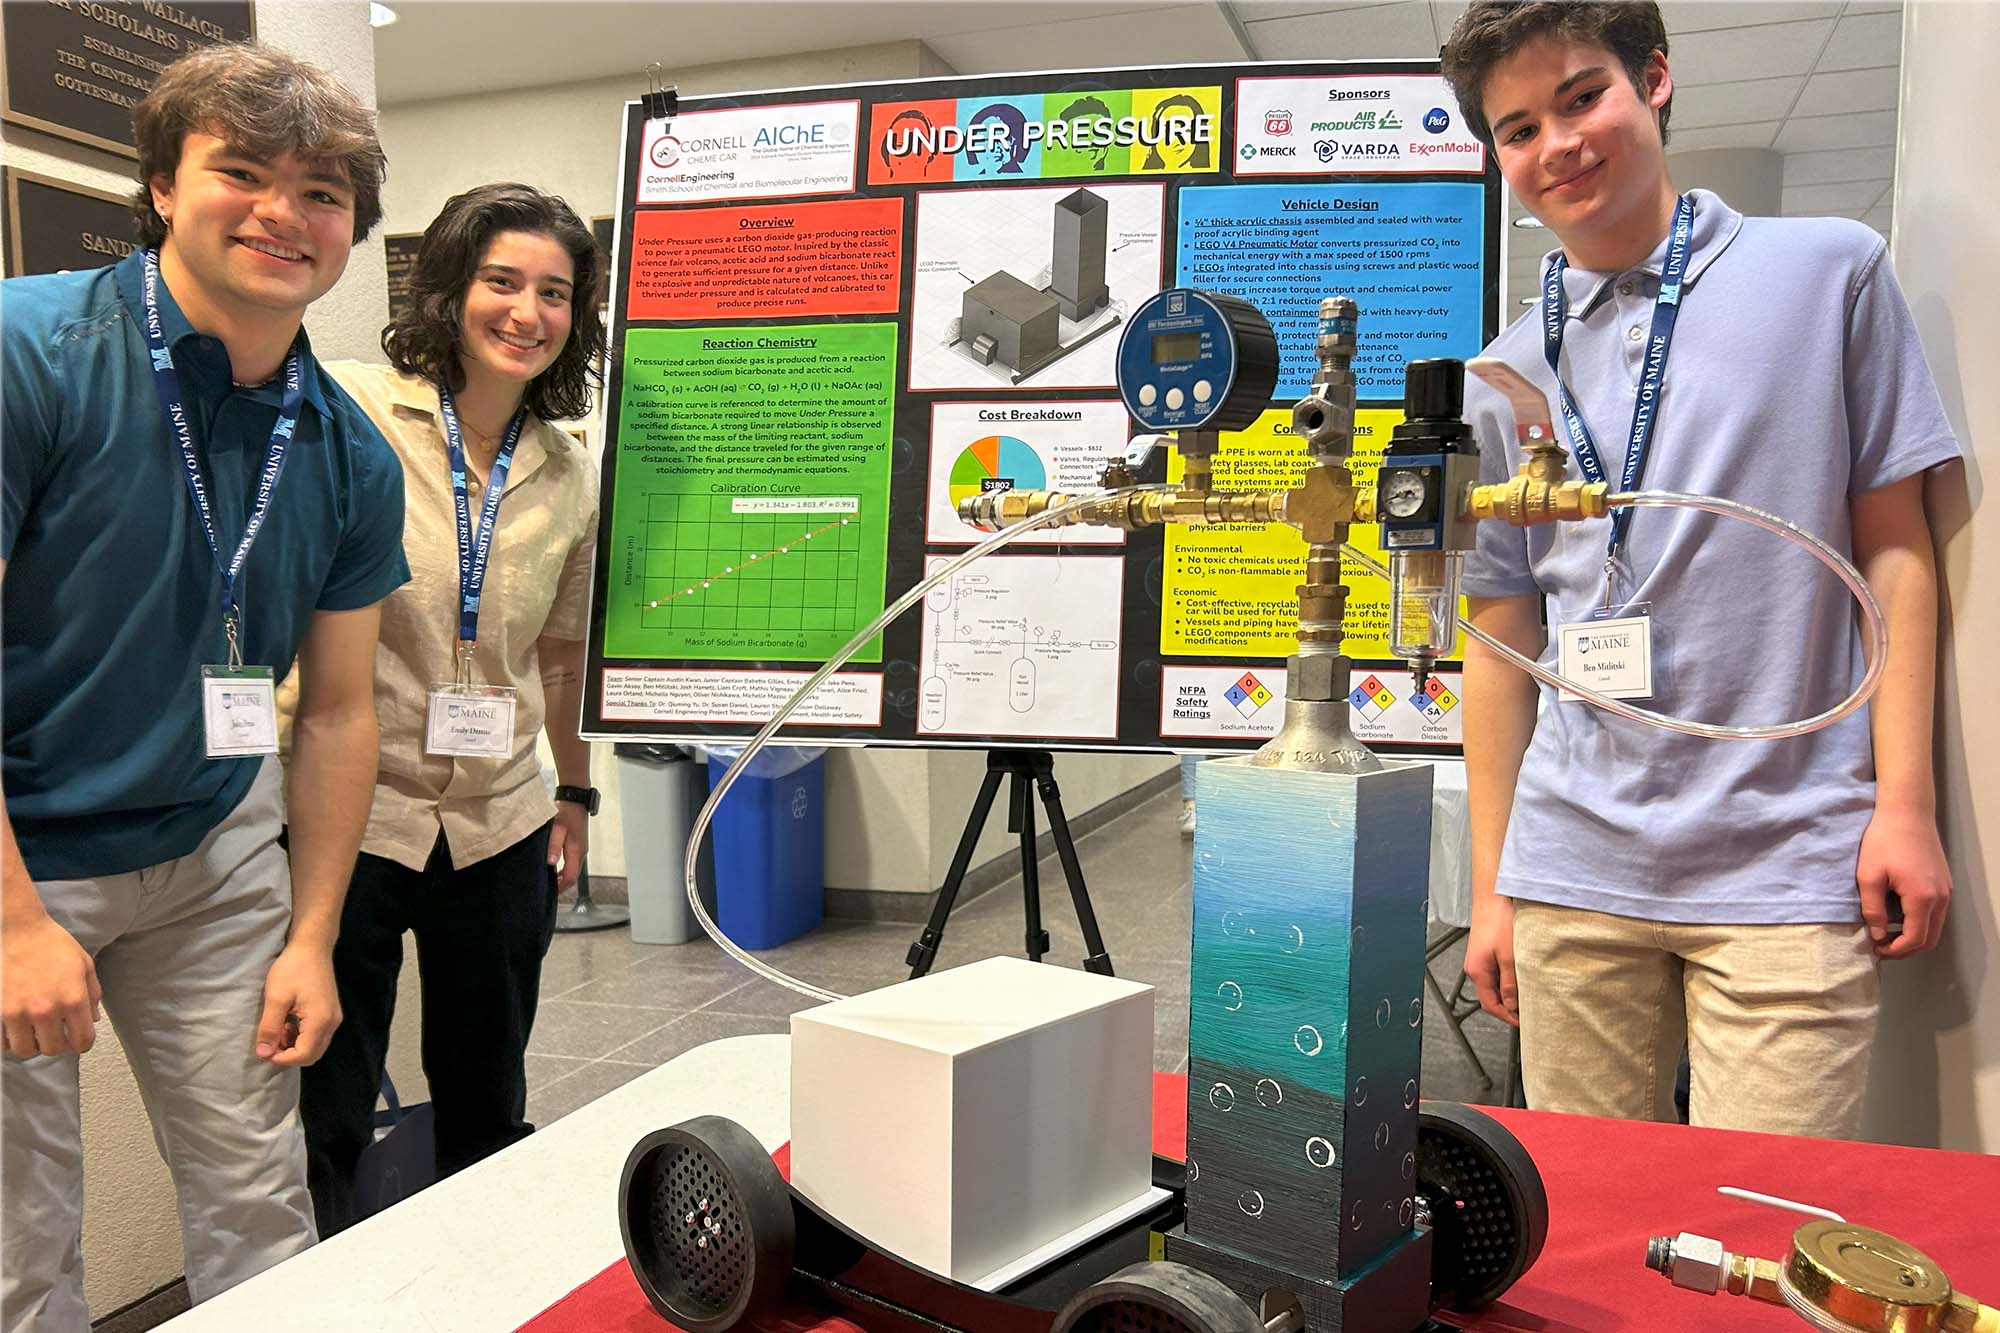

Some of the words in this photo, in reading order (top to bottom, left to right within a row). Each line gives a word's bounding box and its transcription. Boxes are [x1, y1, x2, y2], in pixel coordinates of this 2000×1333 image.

[79, 0, 179, 50] SCHOLARS
[141, 0, 224, 42] WALLACH
[56, 50, 86, 70] THE
[1329, 89, 1390, 98] Sponsors
[1354, 112, 1376, 121] AIR
[1427, 116, 1447, 127] P&G
[1268, 120, 1289, 131] 66
[1310, 122, 1376, 131] PRODUCTS
[754, 124, 824, 147] AIChE
[886, 122, 1012, 156] UNDER
[1022, 113, 1215, 149] PRESSURE
[680, 135, 747, 153] CORNELL
[1342, 144, 1399, 155] VARDA
[1409, 143, 1479, 156] ExxonMobil
[1260, 147, 1296, 157] MERCK
[687, 154, 717, 165] CHEME
[719, 152, 737, 162] CAR
[647, 170, 735, 184] CornellEngineering
[645, 186, 667, 194] Smith
[668, 185, 694, 193] School
[695, 184, 703, 192] of
[703, 181, 737, 191] Chemical
[755, 178, 803, 188] Biomolecular
[804, 175, 848, 186] Engineering
[1282, 199, 1329, 209] Vehicle
[1334, 198, 1379, 209] Design
[739, 216, 794, 227] Overview
[638, 238, 665, 246] Under
[666, 238, 703, 246] Pressure
[732, 234, 762, 243] carbon
[764, 232, 795, 242] dioxide
[797, 229, 859, 241] gas-producing
[861, 227, 896, 237] reaction
[1194, 227, 1220, 240] proof
[1222, 228, 1252, 239] acrylic
[1254, 228, 1290, 238] binding
[1292, 228, 1319, 238] agent
[81, 232, 136, 258] SAND
[1668, 212, 1690, 275] UNIVERSITY
[1194, 249, 1245, 261] mechanical
[1248, 253, 1280, 261] energy
[1282, 250, 1303, 259] with
[1336, 250, 1365, 261] speed
[1366, 250, 1377, 259] of
[1380, 250, 1403, 259] 1500
[1406, 251, 1430, 260] rpms
[1193, 272, 1215, 283] filler
[1217, 275, 1231, 283] for
[1266, 274, 1322, 282] connections
[1548, 285, 1559, 301] OF
[717, 299, 752, 309] produce
[753, 298, 784, 308] precise
[1548, 300, 1559, 341] MAINE
[703, 338, 753, 347] Reaction
[757, 337, 817, 346] Chemistry
[633, 357, 684, 366] Pressurized
[685, 358, 714, 366] carbon
[716, 356, 747, 365] dioxide
[749, 358, 765, 366] gas
[767, 356, 774, 364] is
[776, 355, 817, 366] produced
[819, 355, 839, 363] from
[850, 353, 885, 362] reaction
[1646, 335, 1666, 380] MAINE
[663, 369, 700, 377] between
[702, 368, 733, 377] sodium
[735, 364, 786, 375] bicarbonate
[788, 366, 804, 374] and
[806, 365, 832, 374] acetic
[834, 365, 854, 374] acid.
[1642, 384, 1654, 401] OF
[979, 410, 1007, 419] Cost
[1011, 409, 1082, 419] Breakdown
[169, 402, 193, 449] MAINE
[1561, 396, 1590, 456] NIVERSITY
[1583, 455, 1599, 474] OF
[1623, 403, 1650, 485] UNIVERSITY
[184, 450, 198, 470] OF
[655, 464, 715, 477] stoichiometry
[736, 465, 802, 476] thermodynamic
[804, 465, 850, 475] equations.
[255, 445, 284, 519] UNIVERSITY
[985, 481, 1012, 491] $1802
[710, 483, 767, 495] Calibration
[770, 483, 801, 495] Curve
[484, 485, 501, 518] MAINE
[247, 519, 260, 537] OF
[456, 495, 470, 559] UNIVERSITY
[482, 515, 494, 529] OF
[1189, 521, 1227, 533] physical
[1230, 521, 1266, 532] barriers
[1175, 544, 1243, 554] Environmental
[470, 529, 491, 589] UNIVERSITY
[1188, 555, 1201, 564] No
[1203, 555, 1226, 564] toxic
[1229, 556, 1275, 564] chemicals
[1277, 556, 1300, 565] used
[1173, 587, 1217, 596] Economic
[1185, 617, 1221, 626] Vessels
[1223, 618, 1241, 626] and
[1243, 618, 1273, 629] piping
[1275, 618, 1298, 627] have
[685, 638, 705, 646] Mass
[706, 638, 715, 646] of
[716, 638, 745, 646] Sodium
[747, 639, 794, 648] Bicarbonate
[1185, 635, 1248, 646] modifications
[1591, 638, 1630, 650] MAINE
[1584, 663, 1596, 672] Ben
[1180, 686, 1206, 694] NFPA
[1232, 691, 1239, 699] 1
[1176, 697, 1208, 707] Safety
[1355, 694, 1361, 702] 1
[1380, 694, 1387, 702] 0
[1417, 696, 1424, 704] 2
[1443, 696, 1450, 704] 0
[460, 708, 496, 719] MAINE
[1173, 708, 1211, 719] Ratings
[1427, 707, 1441, 716] SA
[1421, 724, 1447, 732] Carbon
[1421, 733, 1448, 741] Dioxide
